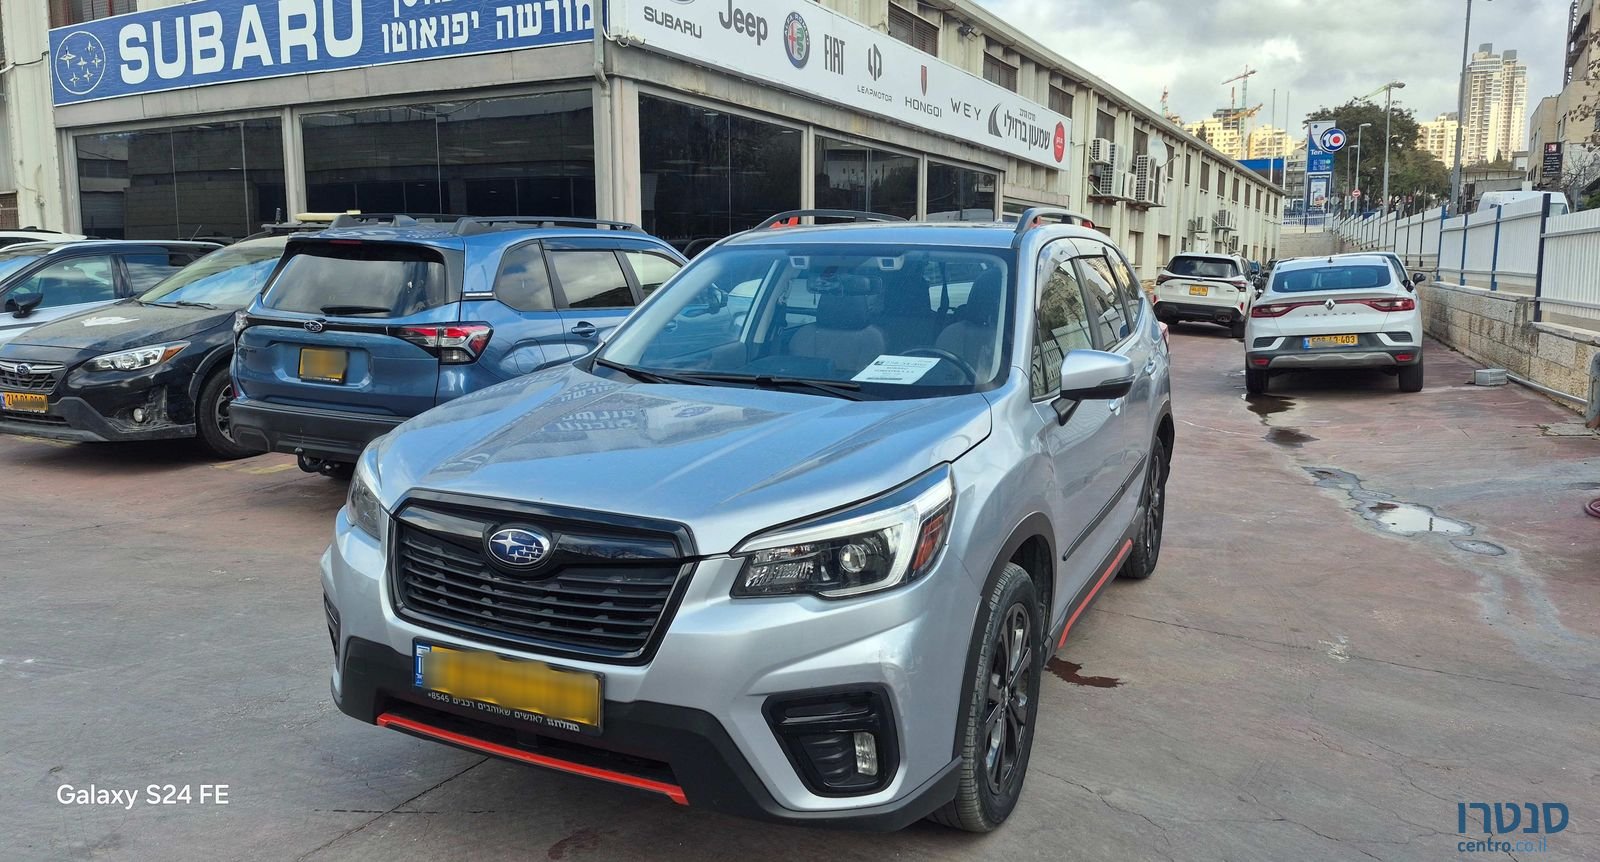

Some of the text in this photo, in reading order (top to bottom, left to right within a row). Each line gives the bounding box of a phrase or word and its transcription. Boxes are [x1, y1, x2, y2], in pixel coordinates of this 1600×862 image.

[381, 10, 479, 54] יפנאוטו
[496, 0, 594, 40] מורשה
[643, 6, 702, 39] SUBARU
[718, 0, 768, 46] Jeep
[118, 0, 363, 85] SUBARU
[823, 34, 846, 76] FIAT
[856, 84, 893, 103] LEAPMOTOR
[950, 97, 982, 121] WEY
[452, 697, 475, 709] רכבים
[477, 702, 511, 716] שאוהבים
